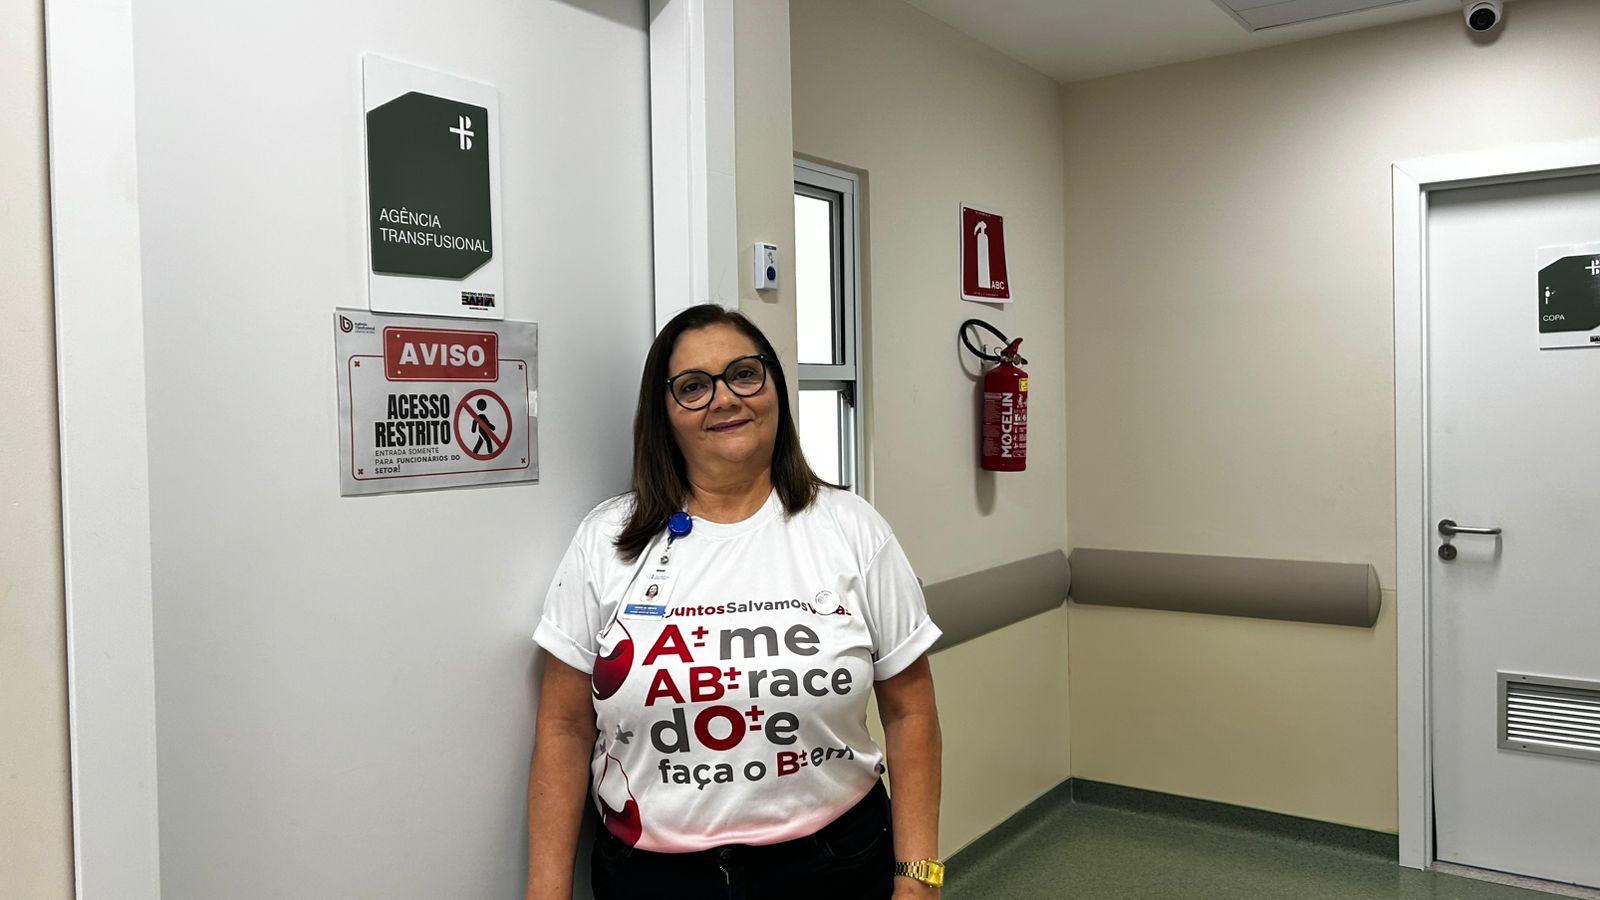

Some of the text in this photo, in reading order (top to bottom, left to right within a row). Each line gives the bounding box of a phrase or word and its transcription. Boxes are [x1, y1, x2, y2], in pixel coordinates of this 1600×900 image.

[379, 206, 442, 229] AGÊNCIA
[379, 227, 490, 253] TRANSFUSIONAL
[991, 280, 1005, 290] ABC
[1542, 314, 1565, 322] COPA
[399, 342, 486, 367] AVISO
[387, 393, 450, 420] ACESSO
[374, 420, 451, 448] RESTRITO
[1001, 392, 1014, 458] MOCELIN
[375, 447, 440, 457] ENTRADA SOMENTE
[396, 453, 448, 464] FUNCIONÁRIOS
[374, 464, 401, 474] SETOR!
[658, 759, 734, 790] faça
[743, 761, 767, 782] o
